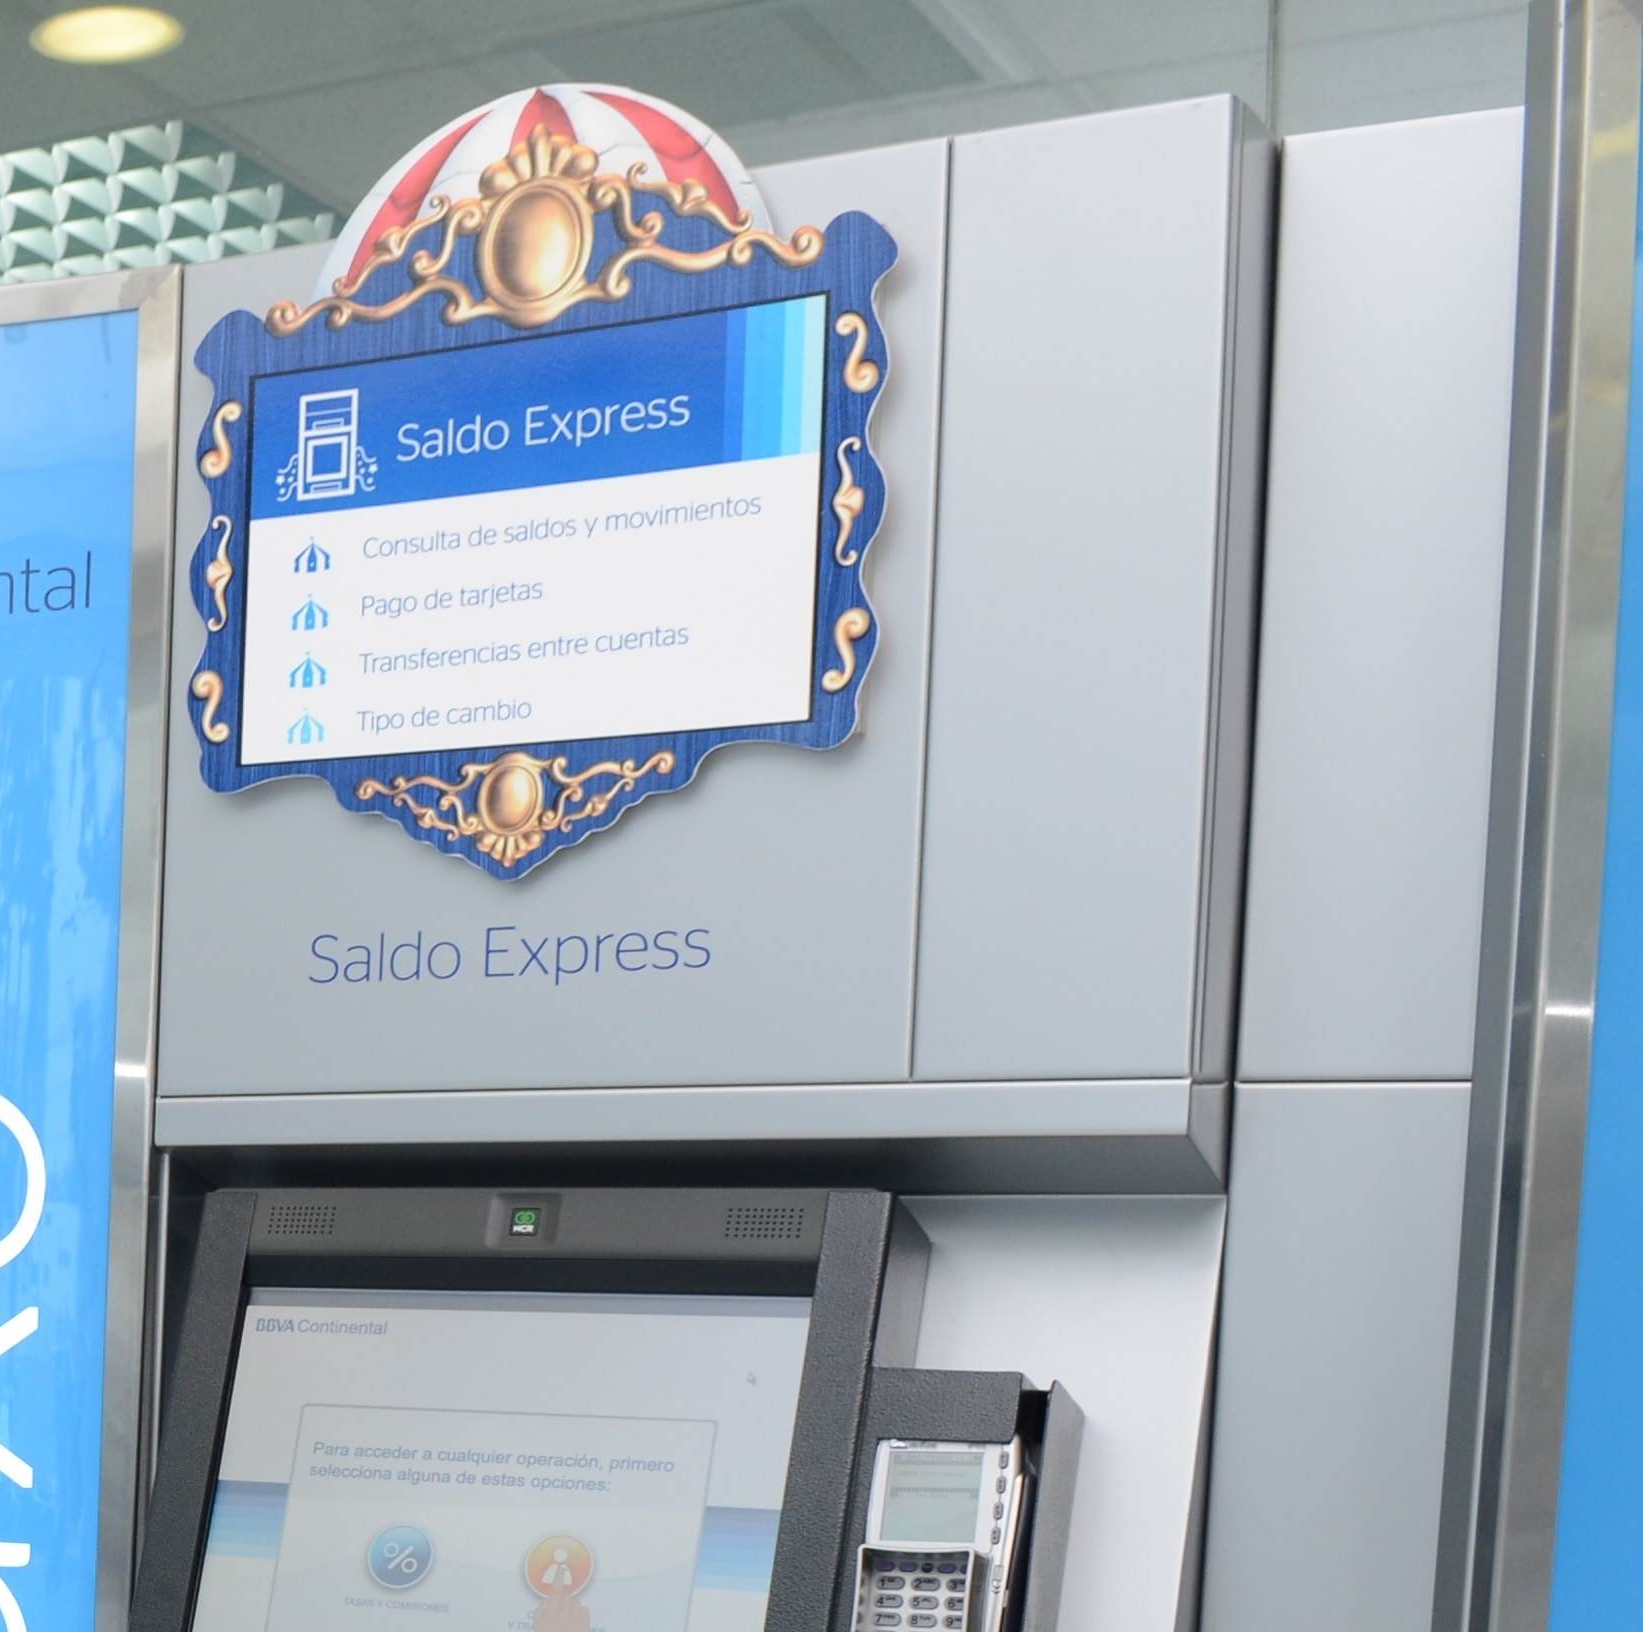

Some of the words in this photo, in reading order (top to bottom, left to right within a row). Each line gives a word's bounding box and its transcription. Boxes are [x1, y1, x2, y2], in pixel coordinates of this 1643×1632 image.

[395, 413, 510, 464] Saldo
[523, 391, 692, 450] Express
[362, 526, 461, 561] Consulta
[467, 520, 498, 548] de
[503, 511, 577, 544] saldos
[584, 515, 598, 539] y
[603, 492, 762, 533] movimientos
[360, 591, 418, 622] Pago
[423, 584, 453, 611] de
[458, 577, 544, 611] tarjetas
[359, 637, 521, 676] Transferencias
[527, 632, 589, 658] entre
[594, 623, 690, 653] cuentas
[357, 707, 405, 736] Tipo
[410, 703, 440, 728] de
[445, 695, 533, 725] cambio
[308, 929, 462, 986] Saldo
[484, 924, 713, 987] Express
[256, 1318, 295, 1333] BBVA
[297, 1319, 388, 1335] Continental
[313, 1441, 349, 1457] Para
[354, 1446, 416, 1460] acceder
[422, 1450, 432, 1460] a
[437, 1449, 512, 1466] cualquier
[516, 1453, 603, 1470] operación,
[609, 1456, 675, 1473] primero
[309, 1464, 392, 1481] selecciona
[397, 1468, 451, 1485] alguna
[456, 1471, 476, 1485] de
[481, 1473, 525, 1487] estas
[530, 1475, 611, 1491] opciones:
[915, 1579, 922, 1589] 2
[950, 1580, 957, 1589] 3
[344, 1597, 375, 1607] TASAS
[385, 1600, 449, 1613] COMISIONES
[876, 1597, 884, 1605] 4
[912, 1597, 920, 1607] 5
[948, 1599, 955, 1608] 6
[876, 1614, 883, 1623] 7
[911, 1615, 918, 1625] 8
[946, 1617, 953, 1626] 9
